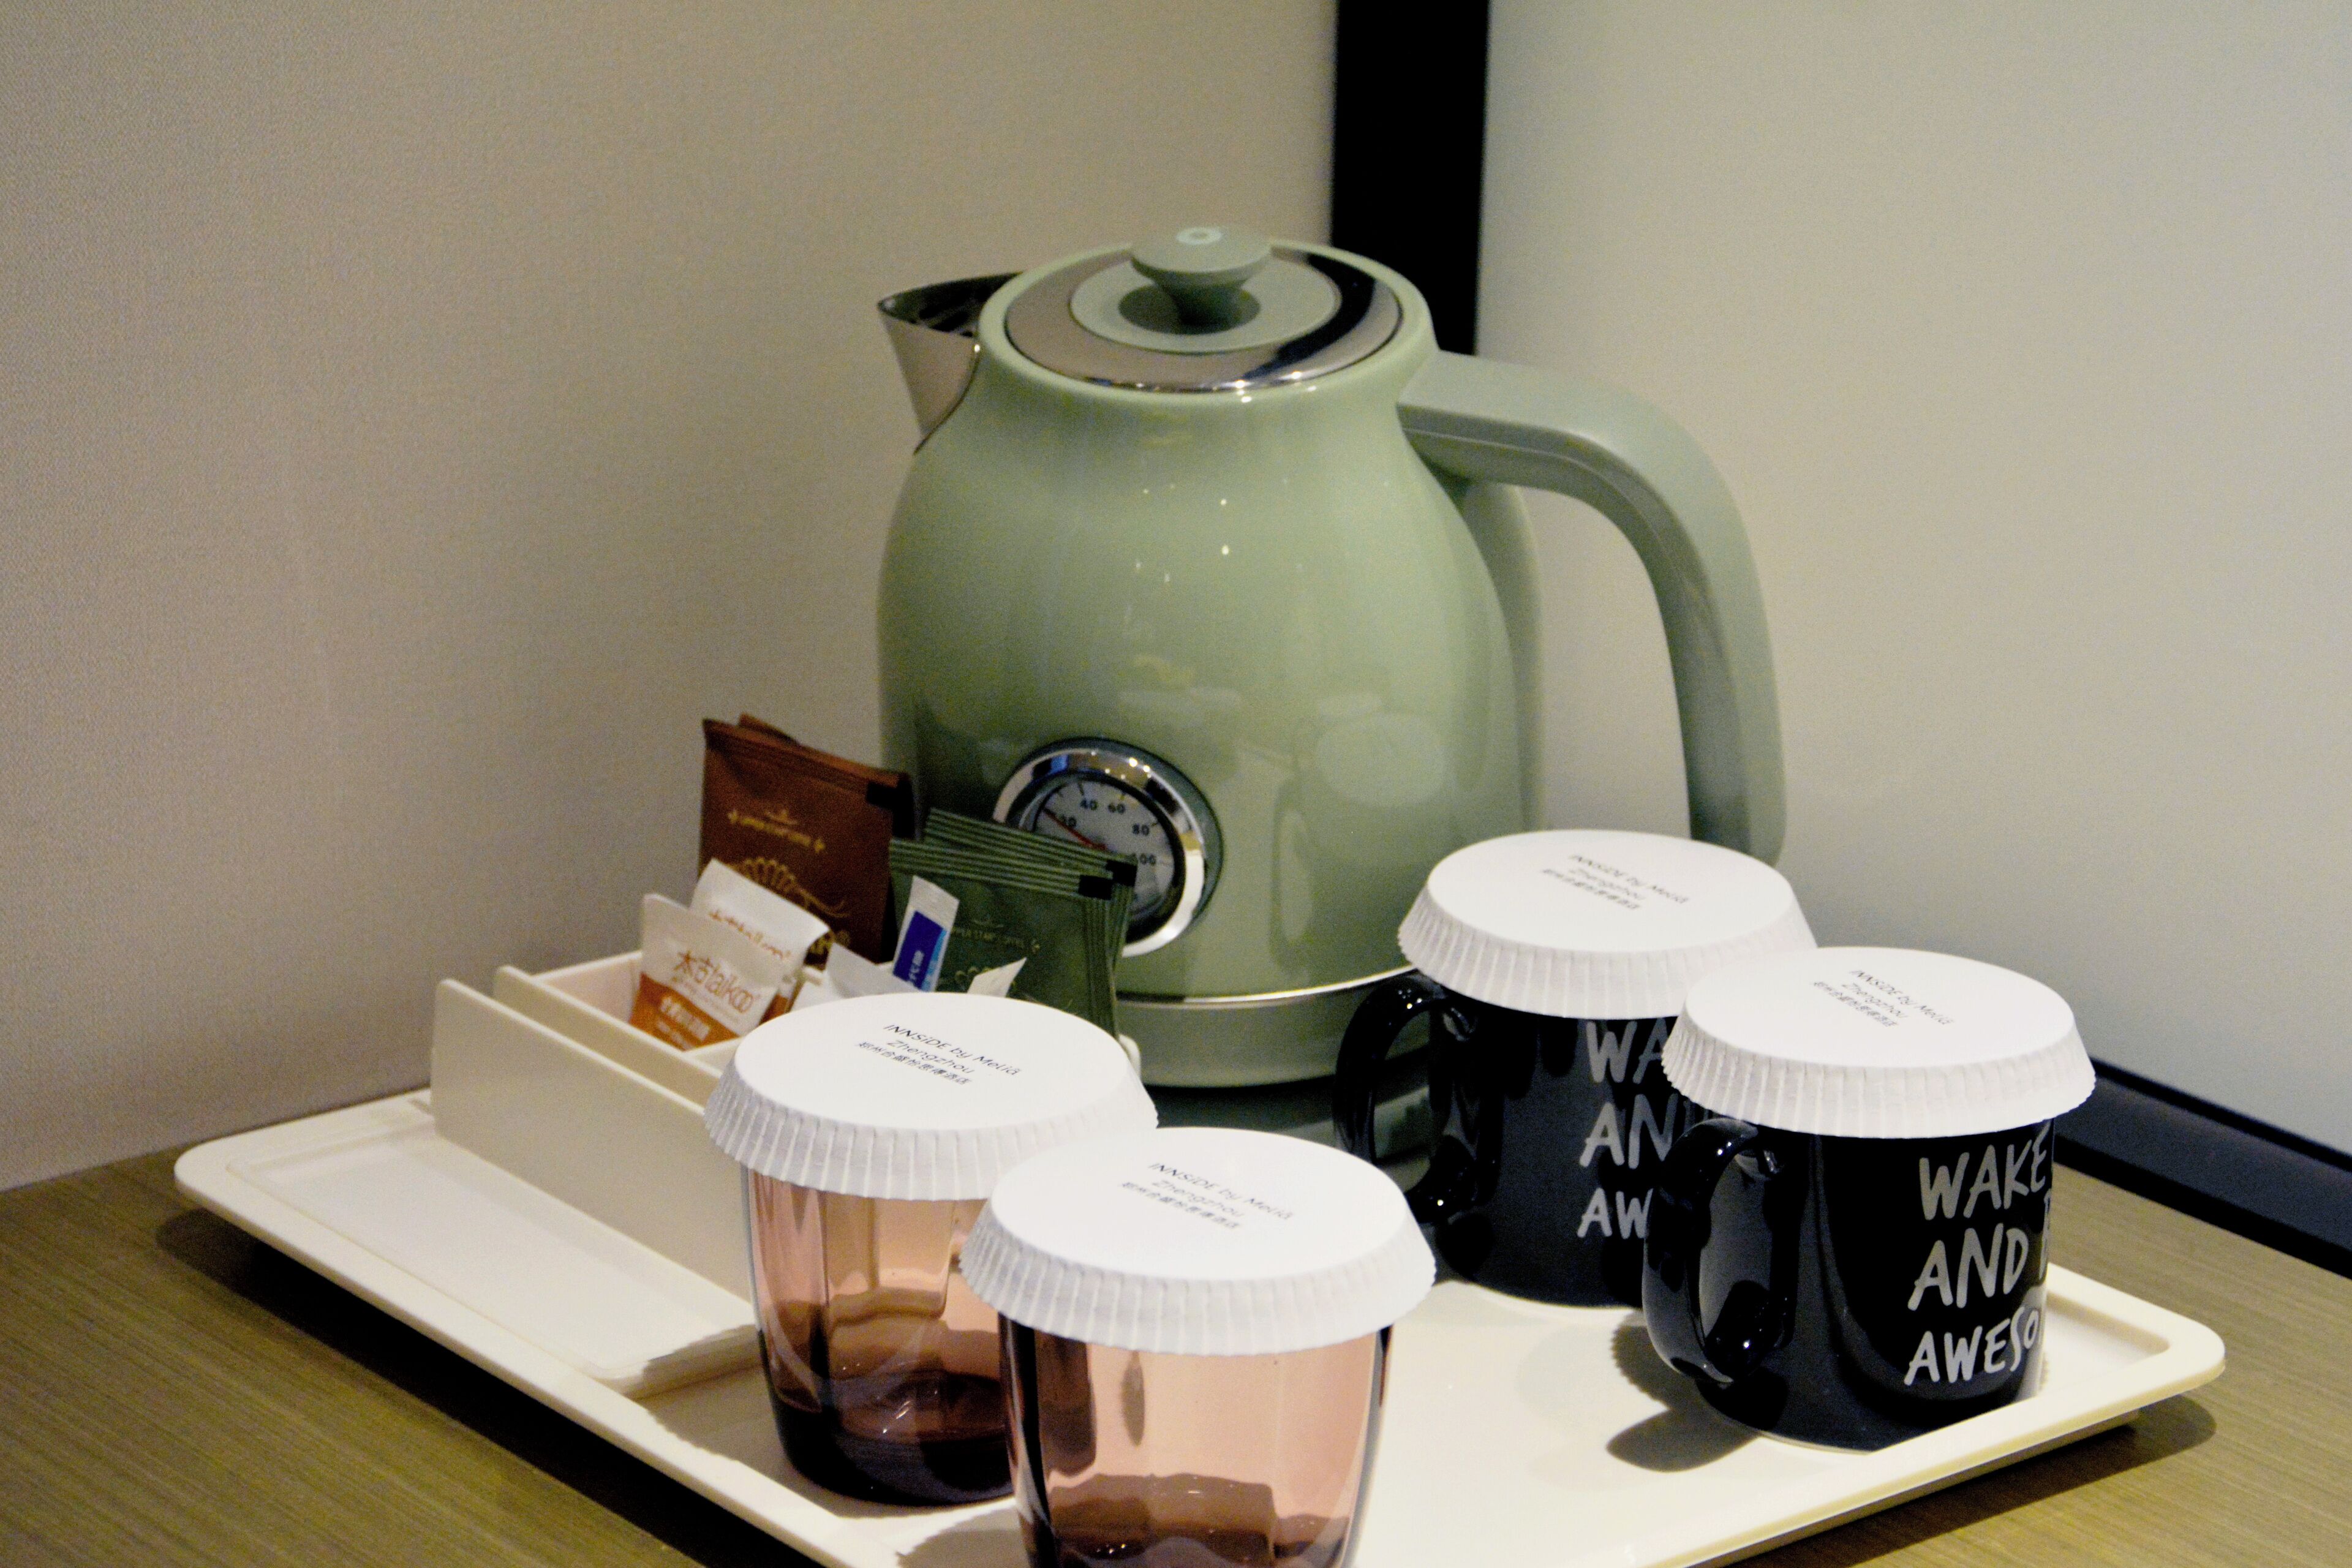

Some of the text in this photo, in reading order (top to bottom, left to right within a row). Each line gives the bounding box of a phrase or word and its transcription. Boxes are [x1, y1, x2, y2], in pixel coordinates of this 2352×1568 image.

[1080, 797, 1098, 810] 40
[1107, 802, 1126, 815] 60
[1132, 823, 1150, 837] 80
[887, 1039, 976, 1074] Zhengzhou
[949, 1047, 974, 1059] by
[1586, 1017, 1668, 1084] WA
[1919, 1121, 2051, 1220] WAKE
[1577, 1186, 1654, 1239] AW
[1907, 1223, 2030, 1311] AND
[1903, 1306, 2040, 1386] AWESO
